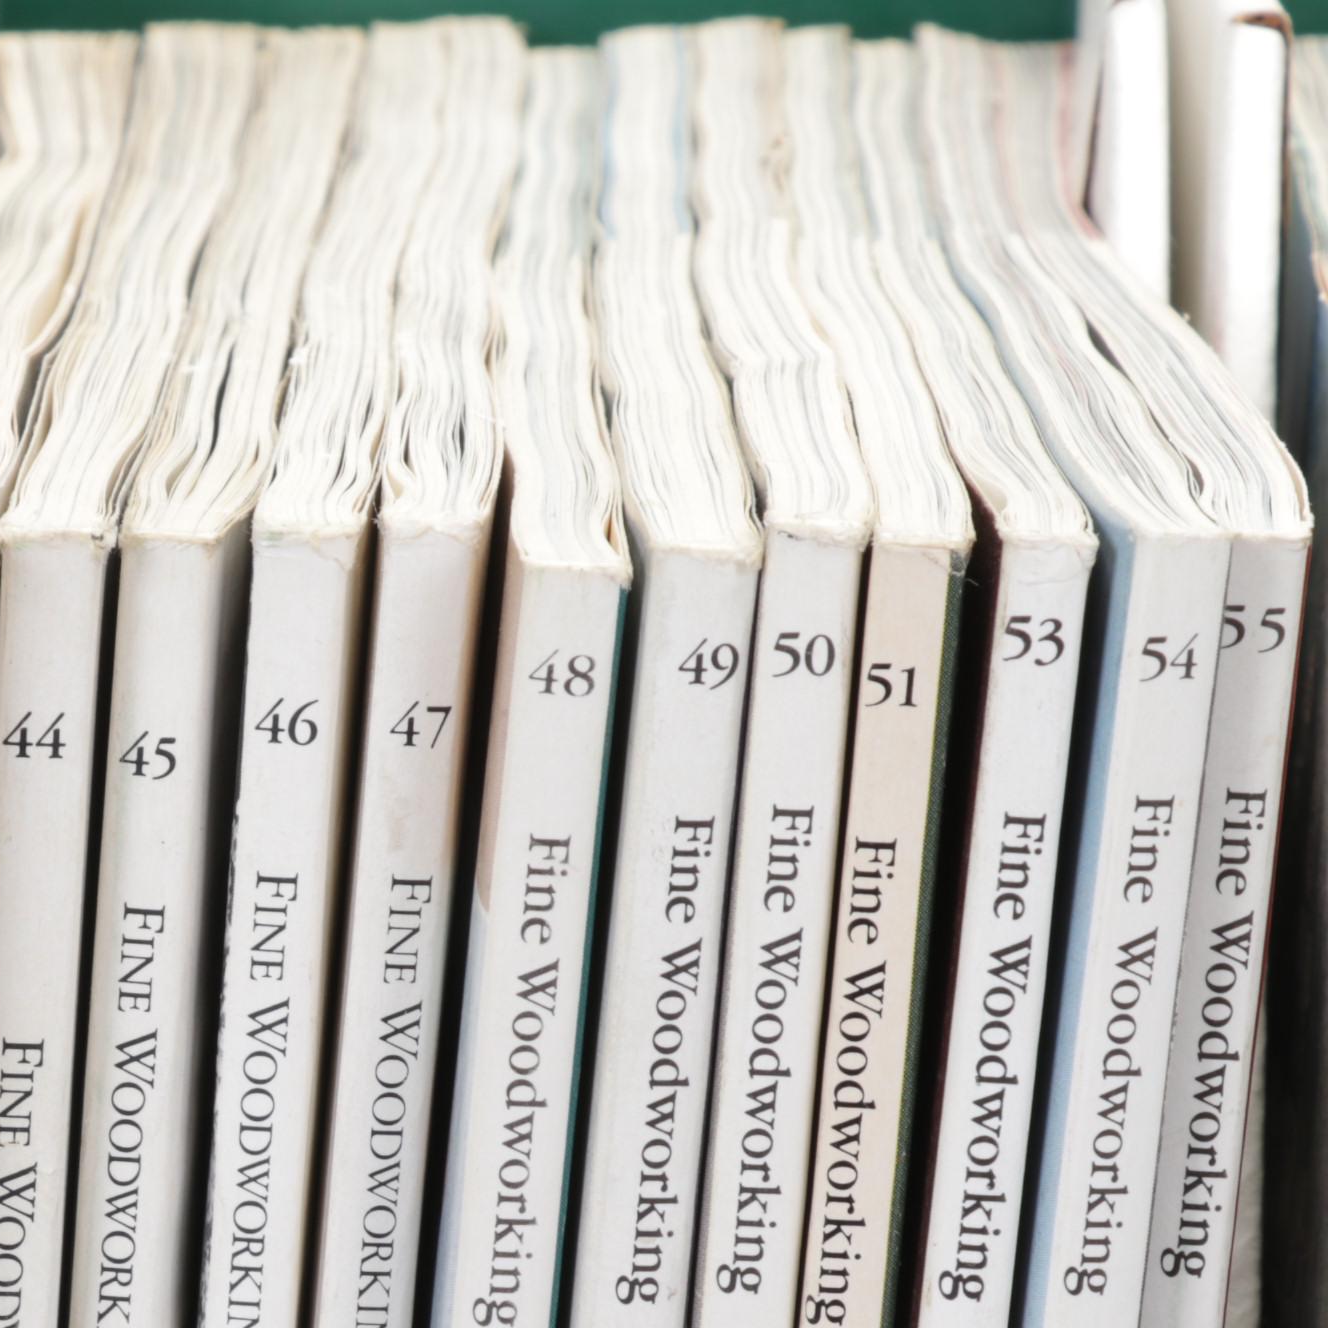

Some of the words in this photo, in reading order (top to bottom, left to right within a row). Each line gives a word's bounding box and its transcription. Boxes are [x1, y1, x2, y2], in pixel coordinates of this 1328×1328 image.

[529, 650, 595, 696] 48
[678, 638, 740, 690] 49
[773, 632, 835, 677] 50
[1003, 616, 1065, 666] 53
[1141, 634, 1198, 681] 54
[1220, 608, 1285, 653] 55
[2, 712, 66, 759] 44
[255, 698, 318, 746] 46
[390, 701, 452, 748] 47
[865, 663, 917, 707] 51
[118, 731, 176, 780] 45
[520, 834, 571, 944] Fine
[665, 816, 715, 923] Fine
[764, 804, 814, 913] Fine
[847, 836, 897, 945] Fine
[993, 812, 1047, 920] Fine
[1123, 795, 1175, 903] Fine
[1215, 787, 1267, 896] Fine
[118, 902, 165, 1012] FINE
[250, 871, 298, 981] FINE
[384, 874, 432, 983] FINE
[473, 959, 559, 1327] Woodworking
[615, 938, 702, 1305] Woodworking
[716, 928, 803, 1294] Woodworking
[805, 960, 886, 1326] Woodworking
[938, 935, 1032, 1302] Woodworking
[1064, 927, 1159, 1296] Woodworking
[1160, 911, 1254, 1278] Woodworking
